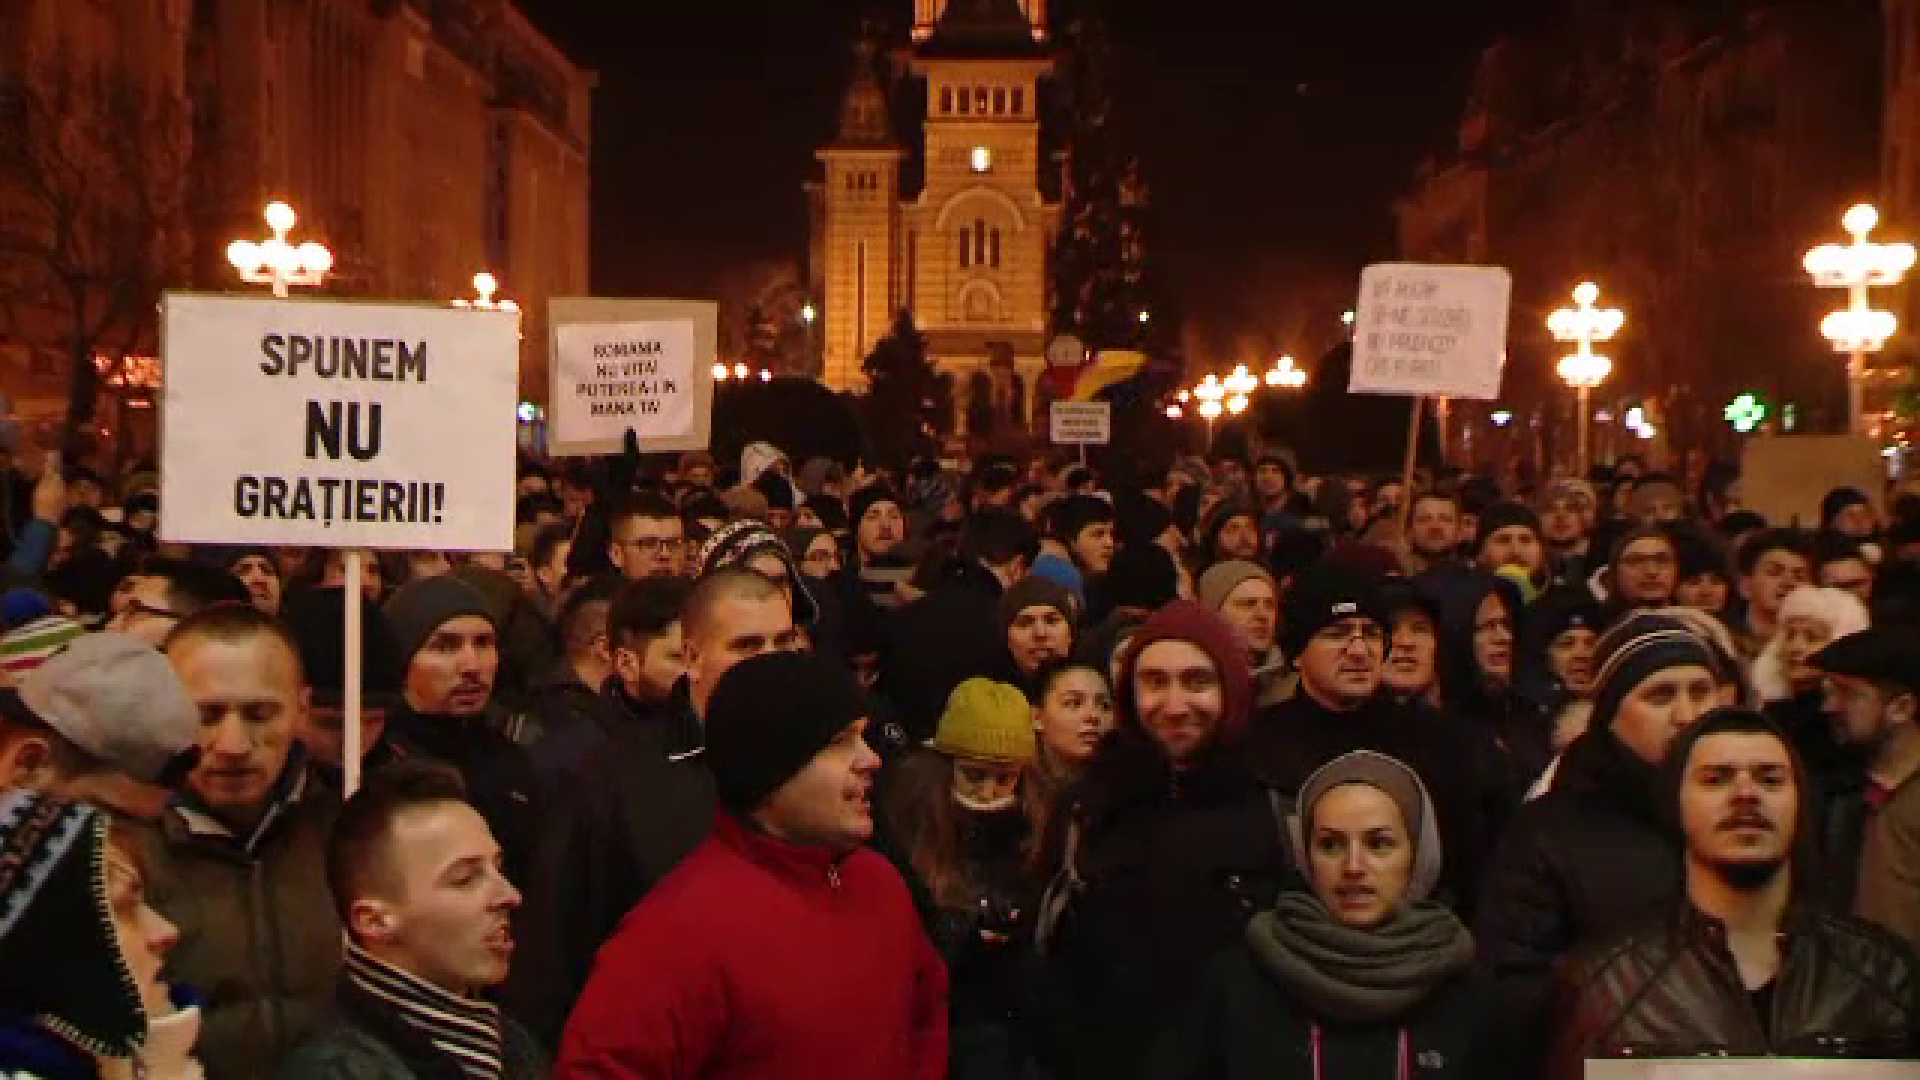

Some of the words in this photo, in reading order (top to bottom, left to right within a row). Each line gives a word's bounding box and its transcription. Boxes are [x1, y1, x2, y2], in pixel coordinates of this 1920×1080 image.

[260, 333, 428, 384] SPUNEM
[304, 399, 382, 461] NU
[234, 474, 445, 528] GRAȚIERII!
